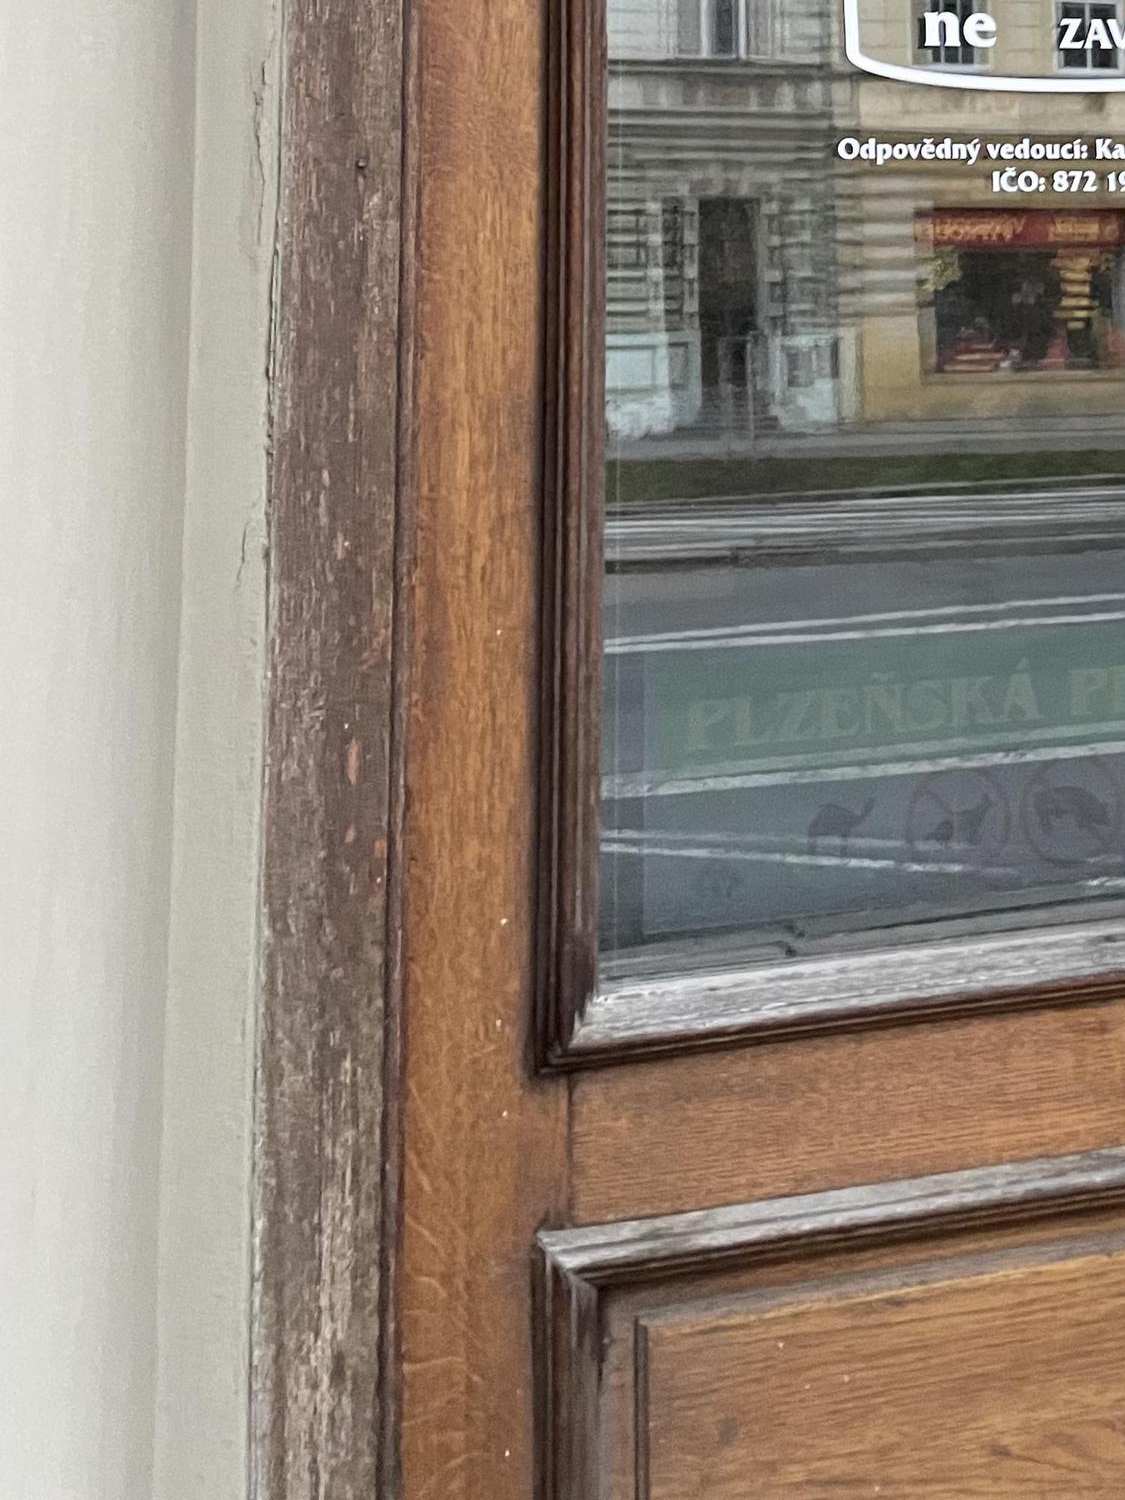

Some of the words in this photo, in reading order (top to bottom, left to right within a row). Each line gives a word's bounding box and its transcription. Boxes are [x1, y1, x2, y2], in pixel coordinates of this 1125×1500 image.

[923, 8, 997, 48] ne
[837, 138, 979, 164] Odpovědný
[987, 138, 1087, 160] vedoucí:
[992, 169, 1046, 192] IČO:
[1052, 171, 1097, 192] 872
[686, 657, 1039, 751] PLZEŇSKÁ
